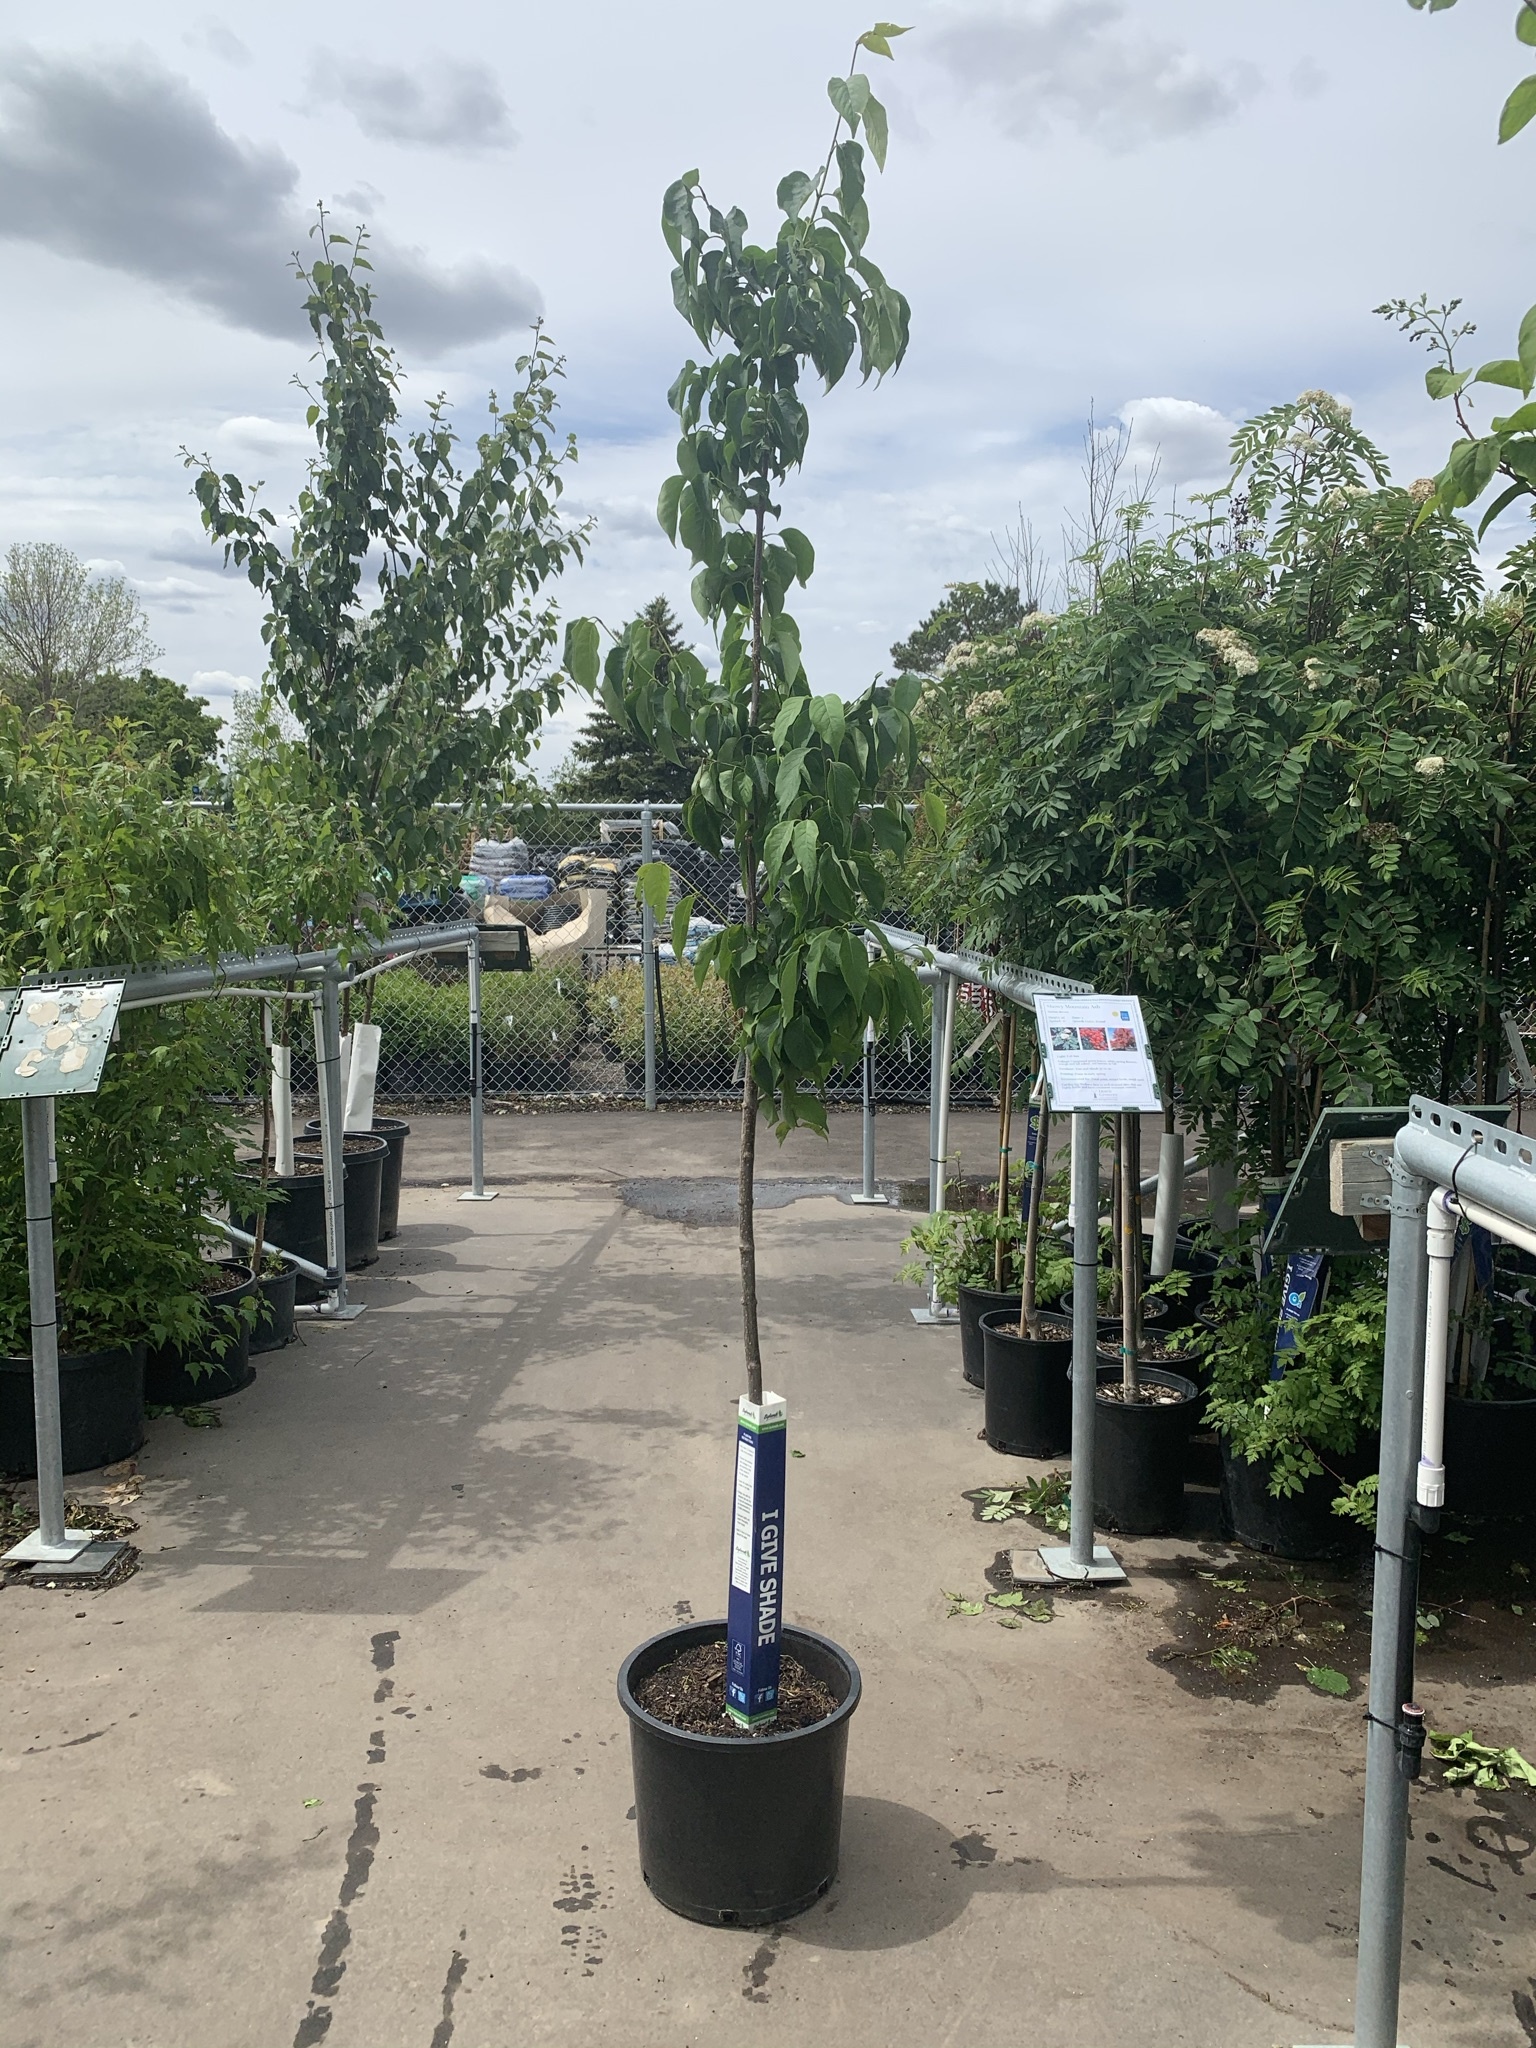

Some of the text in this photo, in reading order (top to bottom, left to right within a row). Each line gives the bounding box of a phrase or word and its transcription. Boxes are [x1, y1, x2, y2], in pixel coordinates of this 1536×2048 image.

[757, 1509, 779, 1647] I GIVE SHADE
